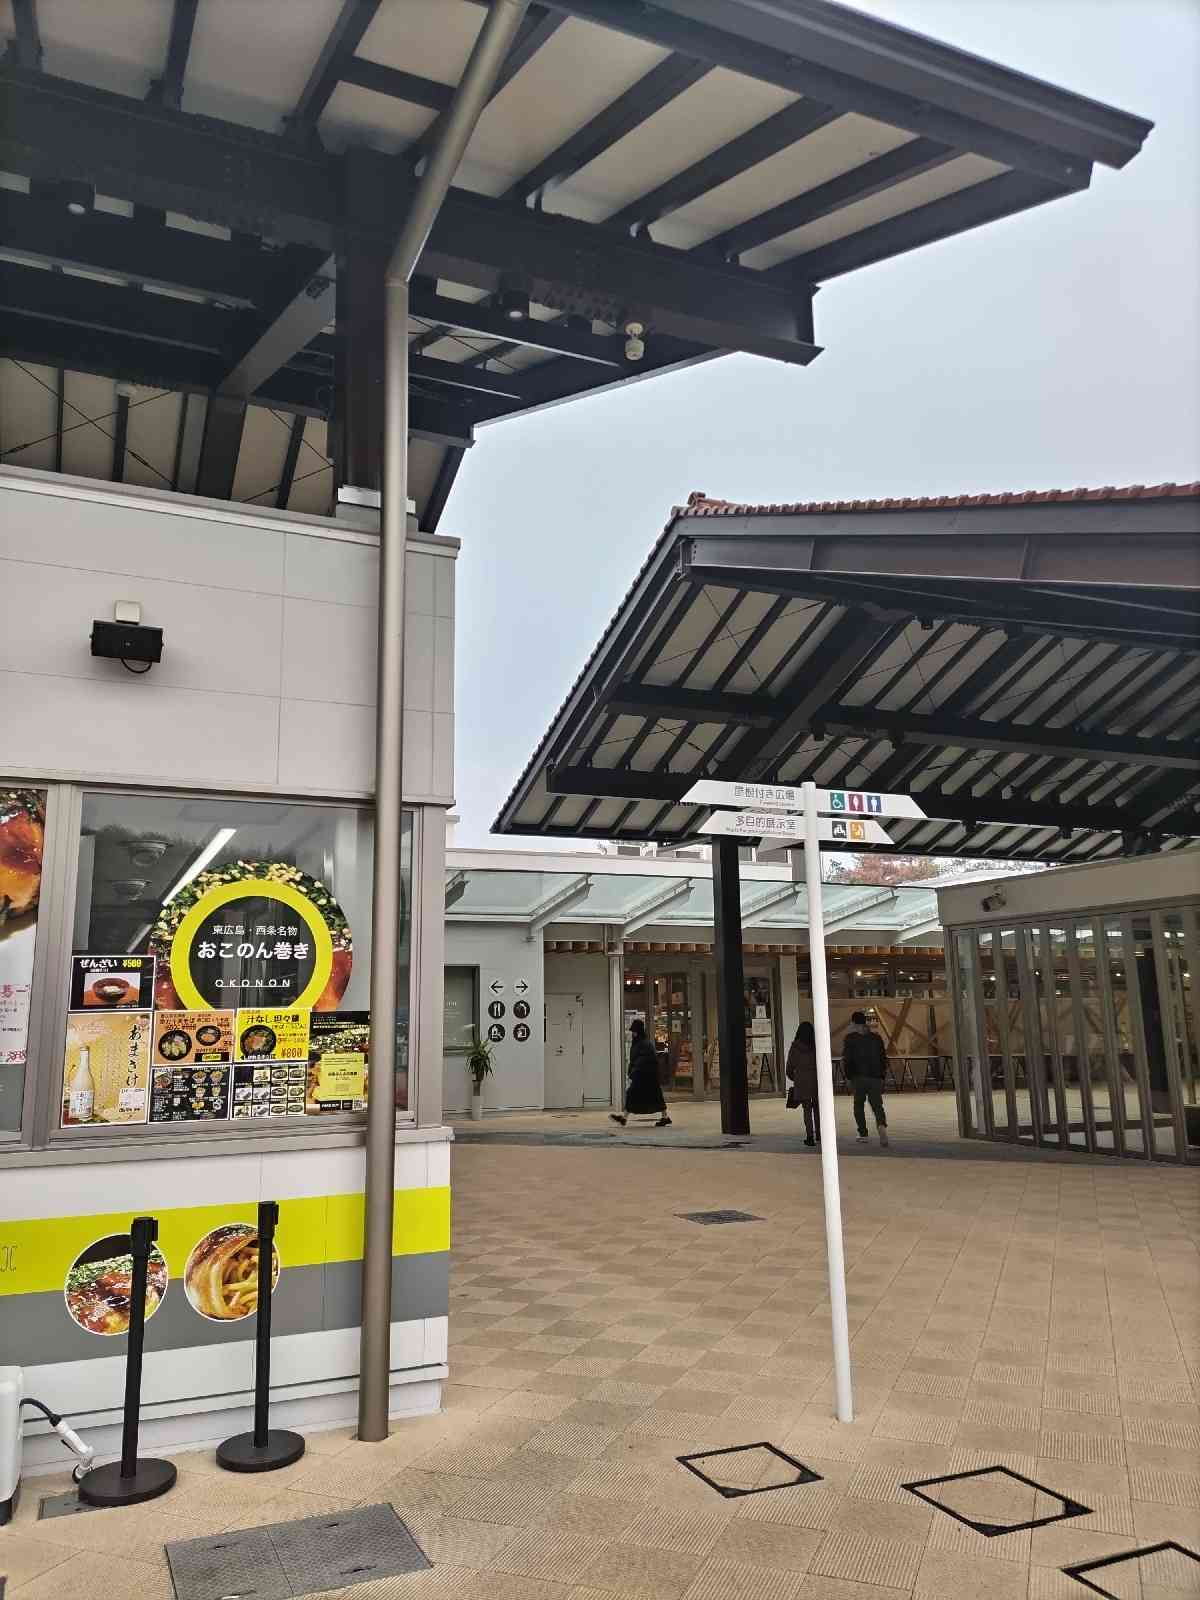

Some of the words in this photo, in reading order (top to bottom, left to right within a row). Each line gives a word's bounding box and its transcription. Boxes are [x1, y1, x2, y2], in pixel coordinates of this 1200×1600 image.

[735, 815, 797, 830] 多目的展示室
[212, 925, 298, 936] 東広島・西条名物
[198, 942, 309, 959] おこのん巻き
[80, 959, 118, 968] ぜんざい
[215, 979, 290, 988] OKONON
